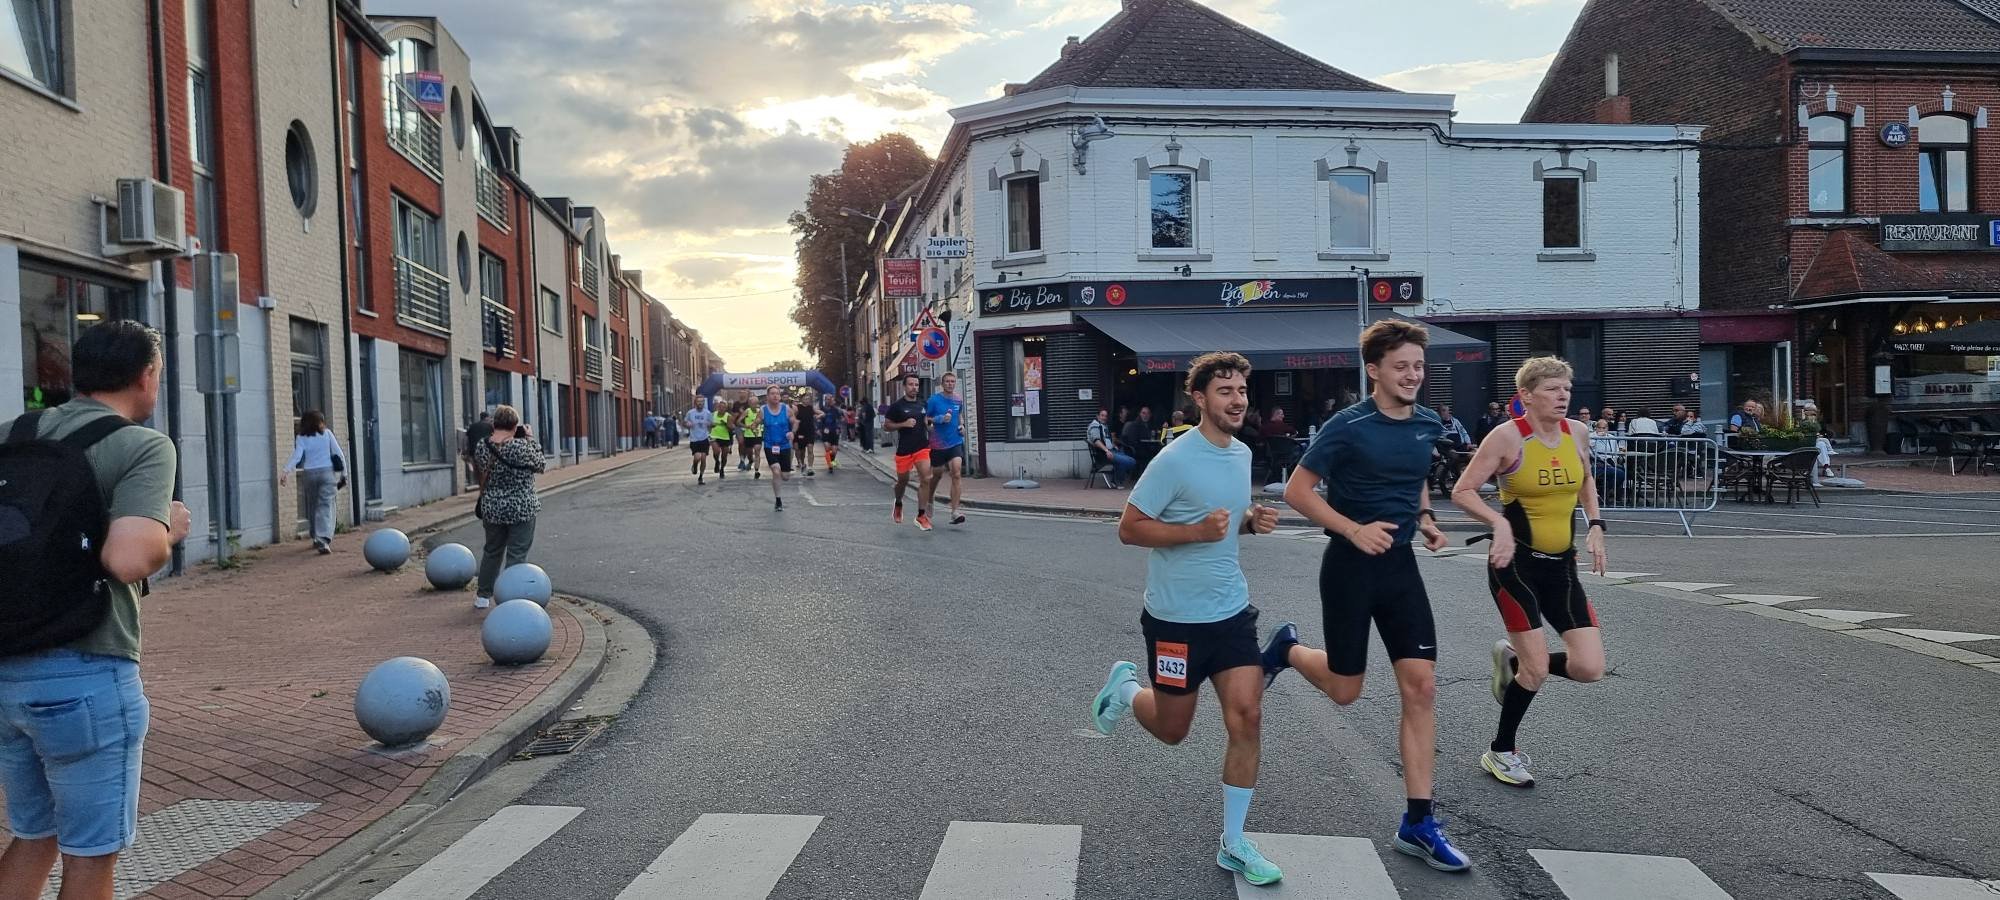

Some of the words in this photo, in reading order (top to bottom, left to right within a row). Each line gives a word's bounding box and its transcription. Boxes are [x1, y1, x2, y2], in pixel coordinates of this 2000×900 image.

[1885, 224, 1980, 241] RESTAURANT
[928, 238, 965, 248] Jupiler
[1010, 288, 1032, 311] Big
[1036, 286, 1063, 306] Ben
[1221, 281, 1246, 306] Big
[1252, 281, 1281, 300] Ben
[936, 339, 944, 347] 31
[739, 376, 799, 385] INTERSPORT
[1538, 468, 1577, 486] BEL
[1159, 660, 1185, 675] 3432
